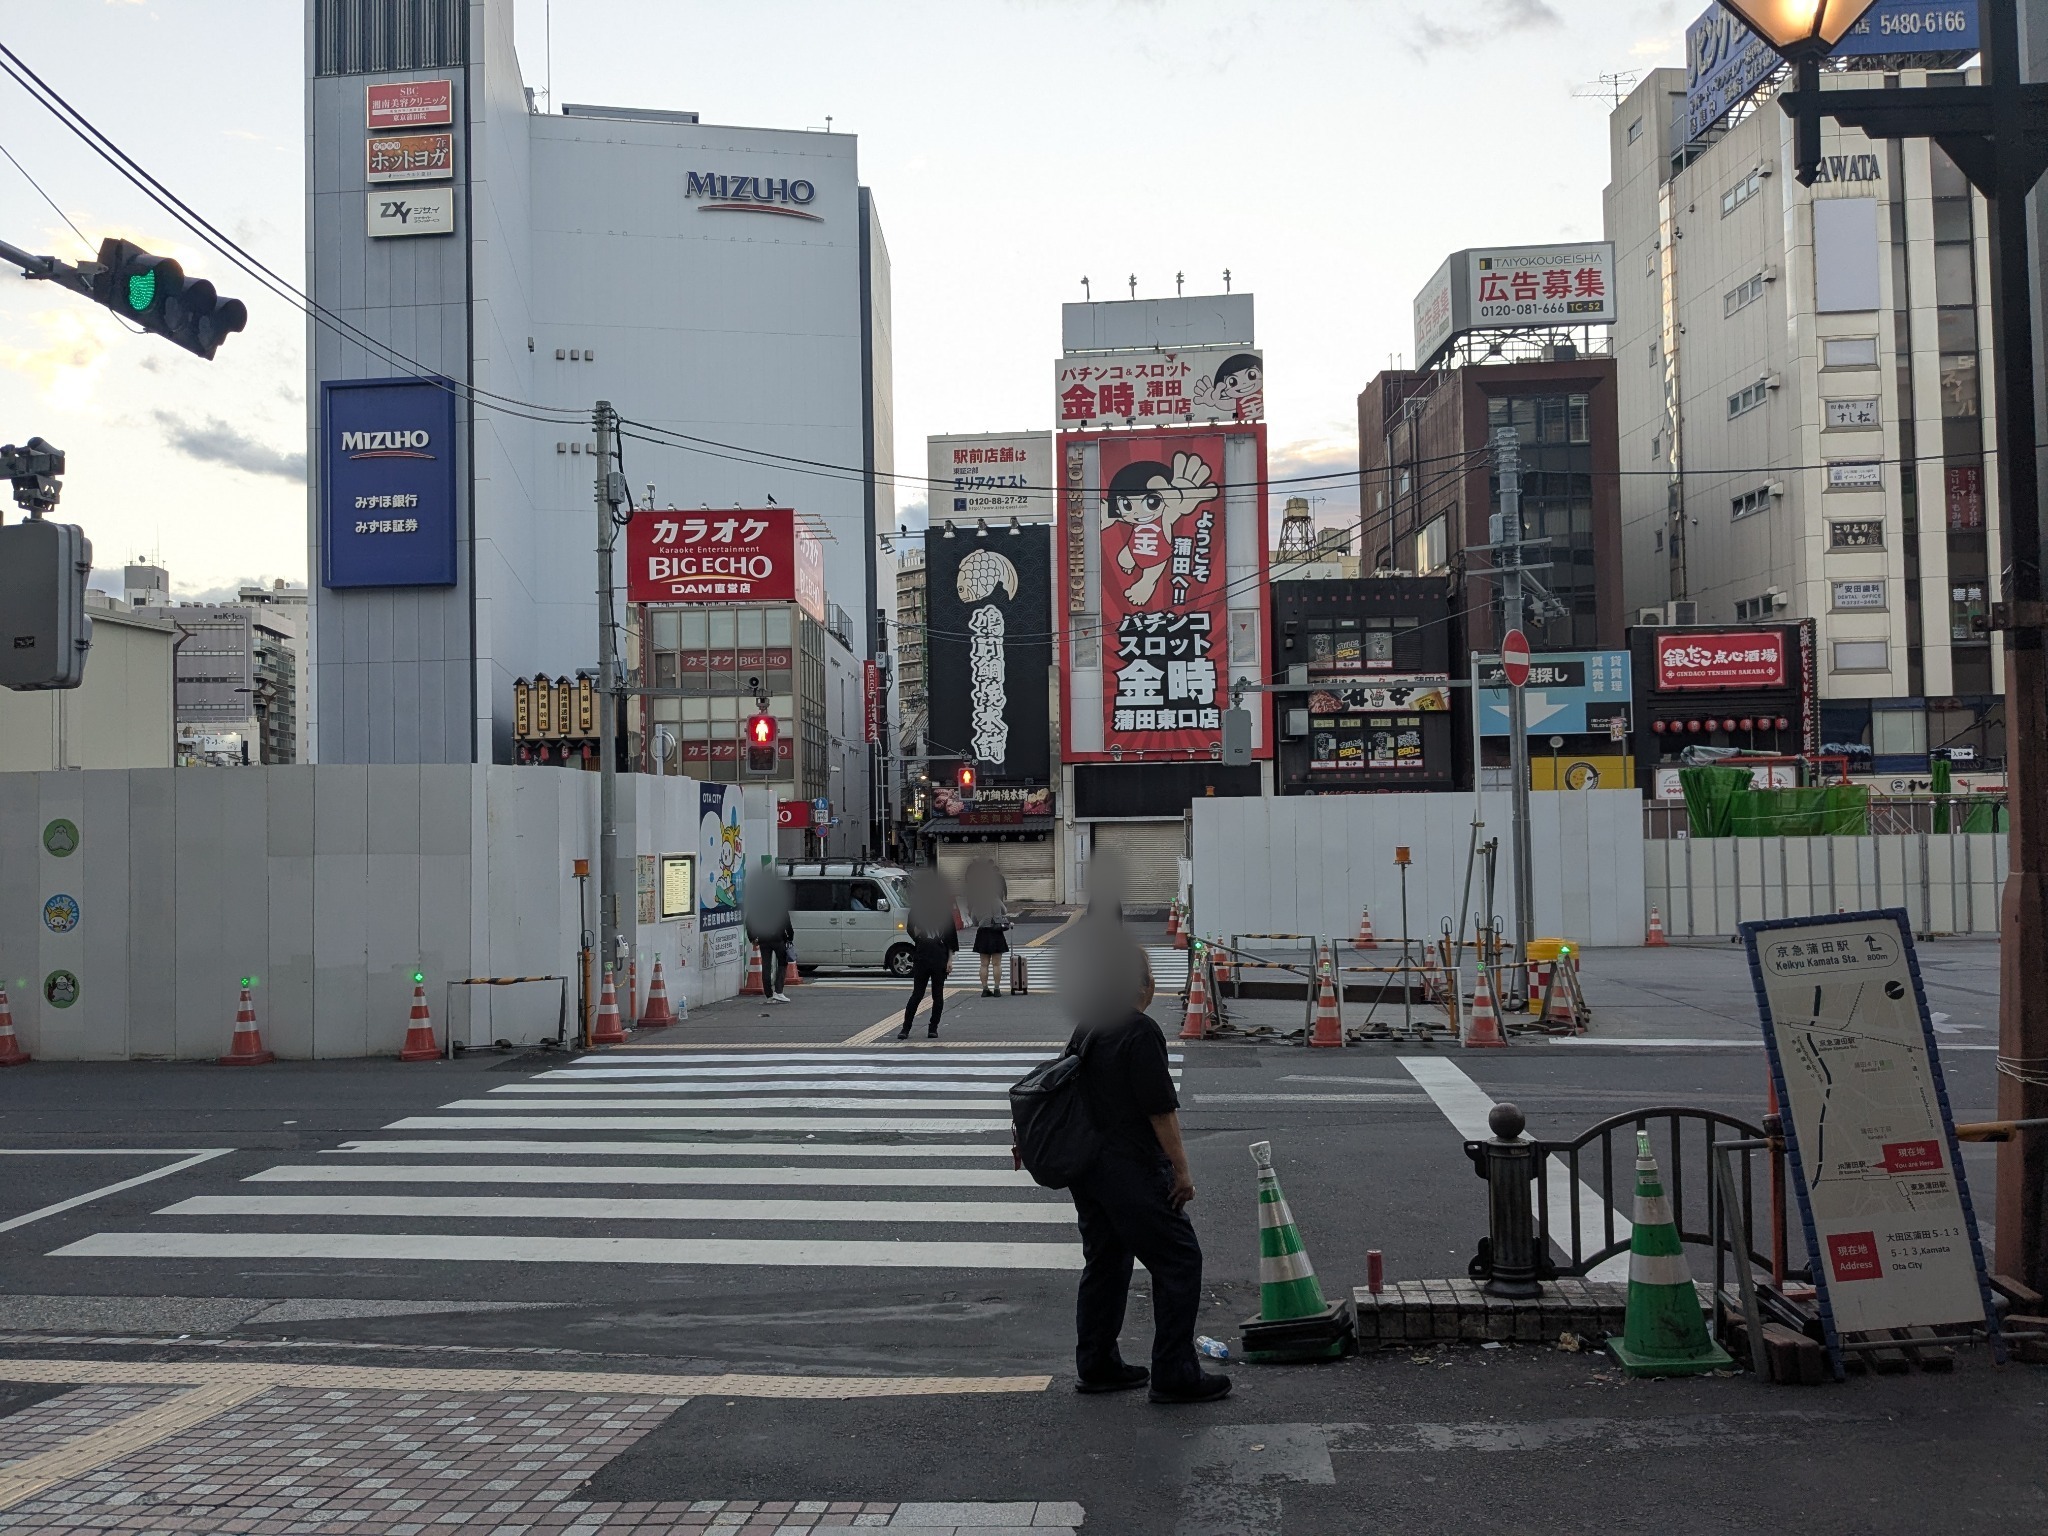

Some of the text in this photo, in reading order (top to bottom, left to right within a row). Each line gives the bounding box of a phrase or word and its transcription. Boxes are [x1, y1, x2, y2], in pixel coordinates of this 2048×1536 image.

[1880, 11, 1966, 35] 5480-6166
[400, 87, 419, 96] SBC
[372, 96, 447, 110] 湘南美容クリニック
[371, 148, 449, 171] ホットヨガ
[685, 171, 816, 203] MIZUHO
[380, 201, 413, 224] ZXY
[1494, 253, 1602, 268] TAIYOKOUGEISHA
[1478, 267, 1605, 303] 広告募集
[1481, 303, 1565, 317] 0120-081-666
[1061, 362, 1191, 382] パチンコ&スロット
[1146, 380, 1182, 398] 蒲田
[1061, 382, 1134, 420] 金時
[1138, 398, 1192, 416] 東口店
[342, 430, 429, 451] MIZUHO
[953, 447, 1027, 464] 駅前店舗は
[954, 474, 1028, 491] エリアクエスト
[355, 494, 418, 508] みずほ銀行
[969, 496, 1028, 506] 0120-88-27-22
[355, 519, 418, 533] みずほ証券
[652, 519, 769, 544] カラオケ
[660, 545, 760, 554] Karaoke Entertainment
[1193, 512, 1216, 583] ようこそ
[649, 555, 773, 581] BIG ECHO
[1118, 612, 1211, 633] パチンコ
[1118, 633, 1212, 657] スロット
[686, 655, 734, 667] カラオケ
[740, 656, 758, 667] BIG
[1663, 644, 1778, 668] 銀だこ点心酒場
[1115, 657, 1217, 706] 金時
[1114, 708, 1221, 731] 蒲田東口店
[687, 745, 735, 756] カラオケ
[1776, 939, 1850, 957] 京急蒲田駅
[1775, 954, 1859, 971] Keikyu Kamata Sta.
[1867, 953, 1888, 961] 800m
[1898, 1146, 1926, 1157] 現在地
[1837, 1244, 1868, 1256] 現在地
[1839, 1261, 1873, 1271] Address
[1907, 1261, 1923, 1270] City
